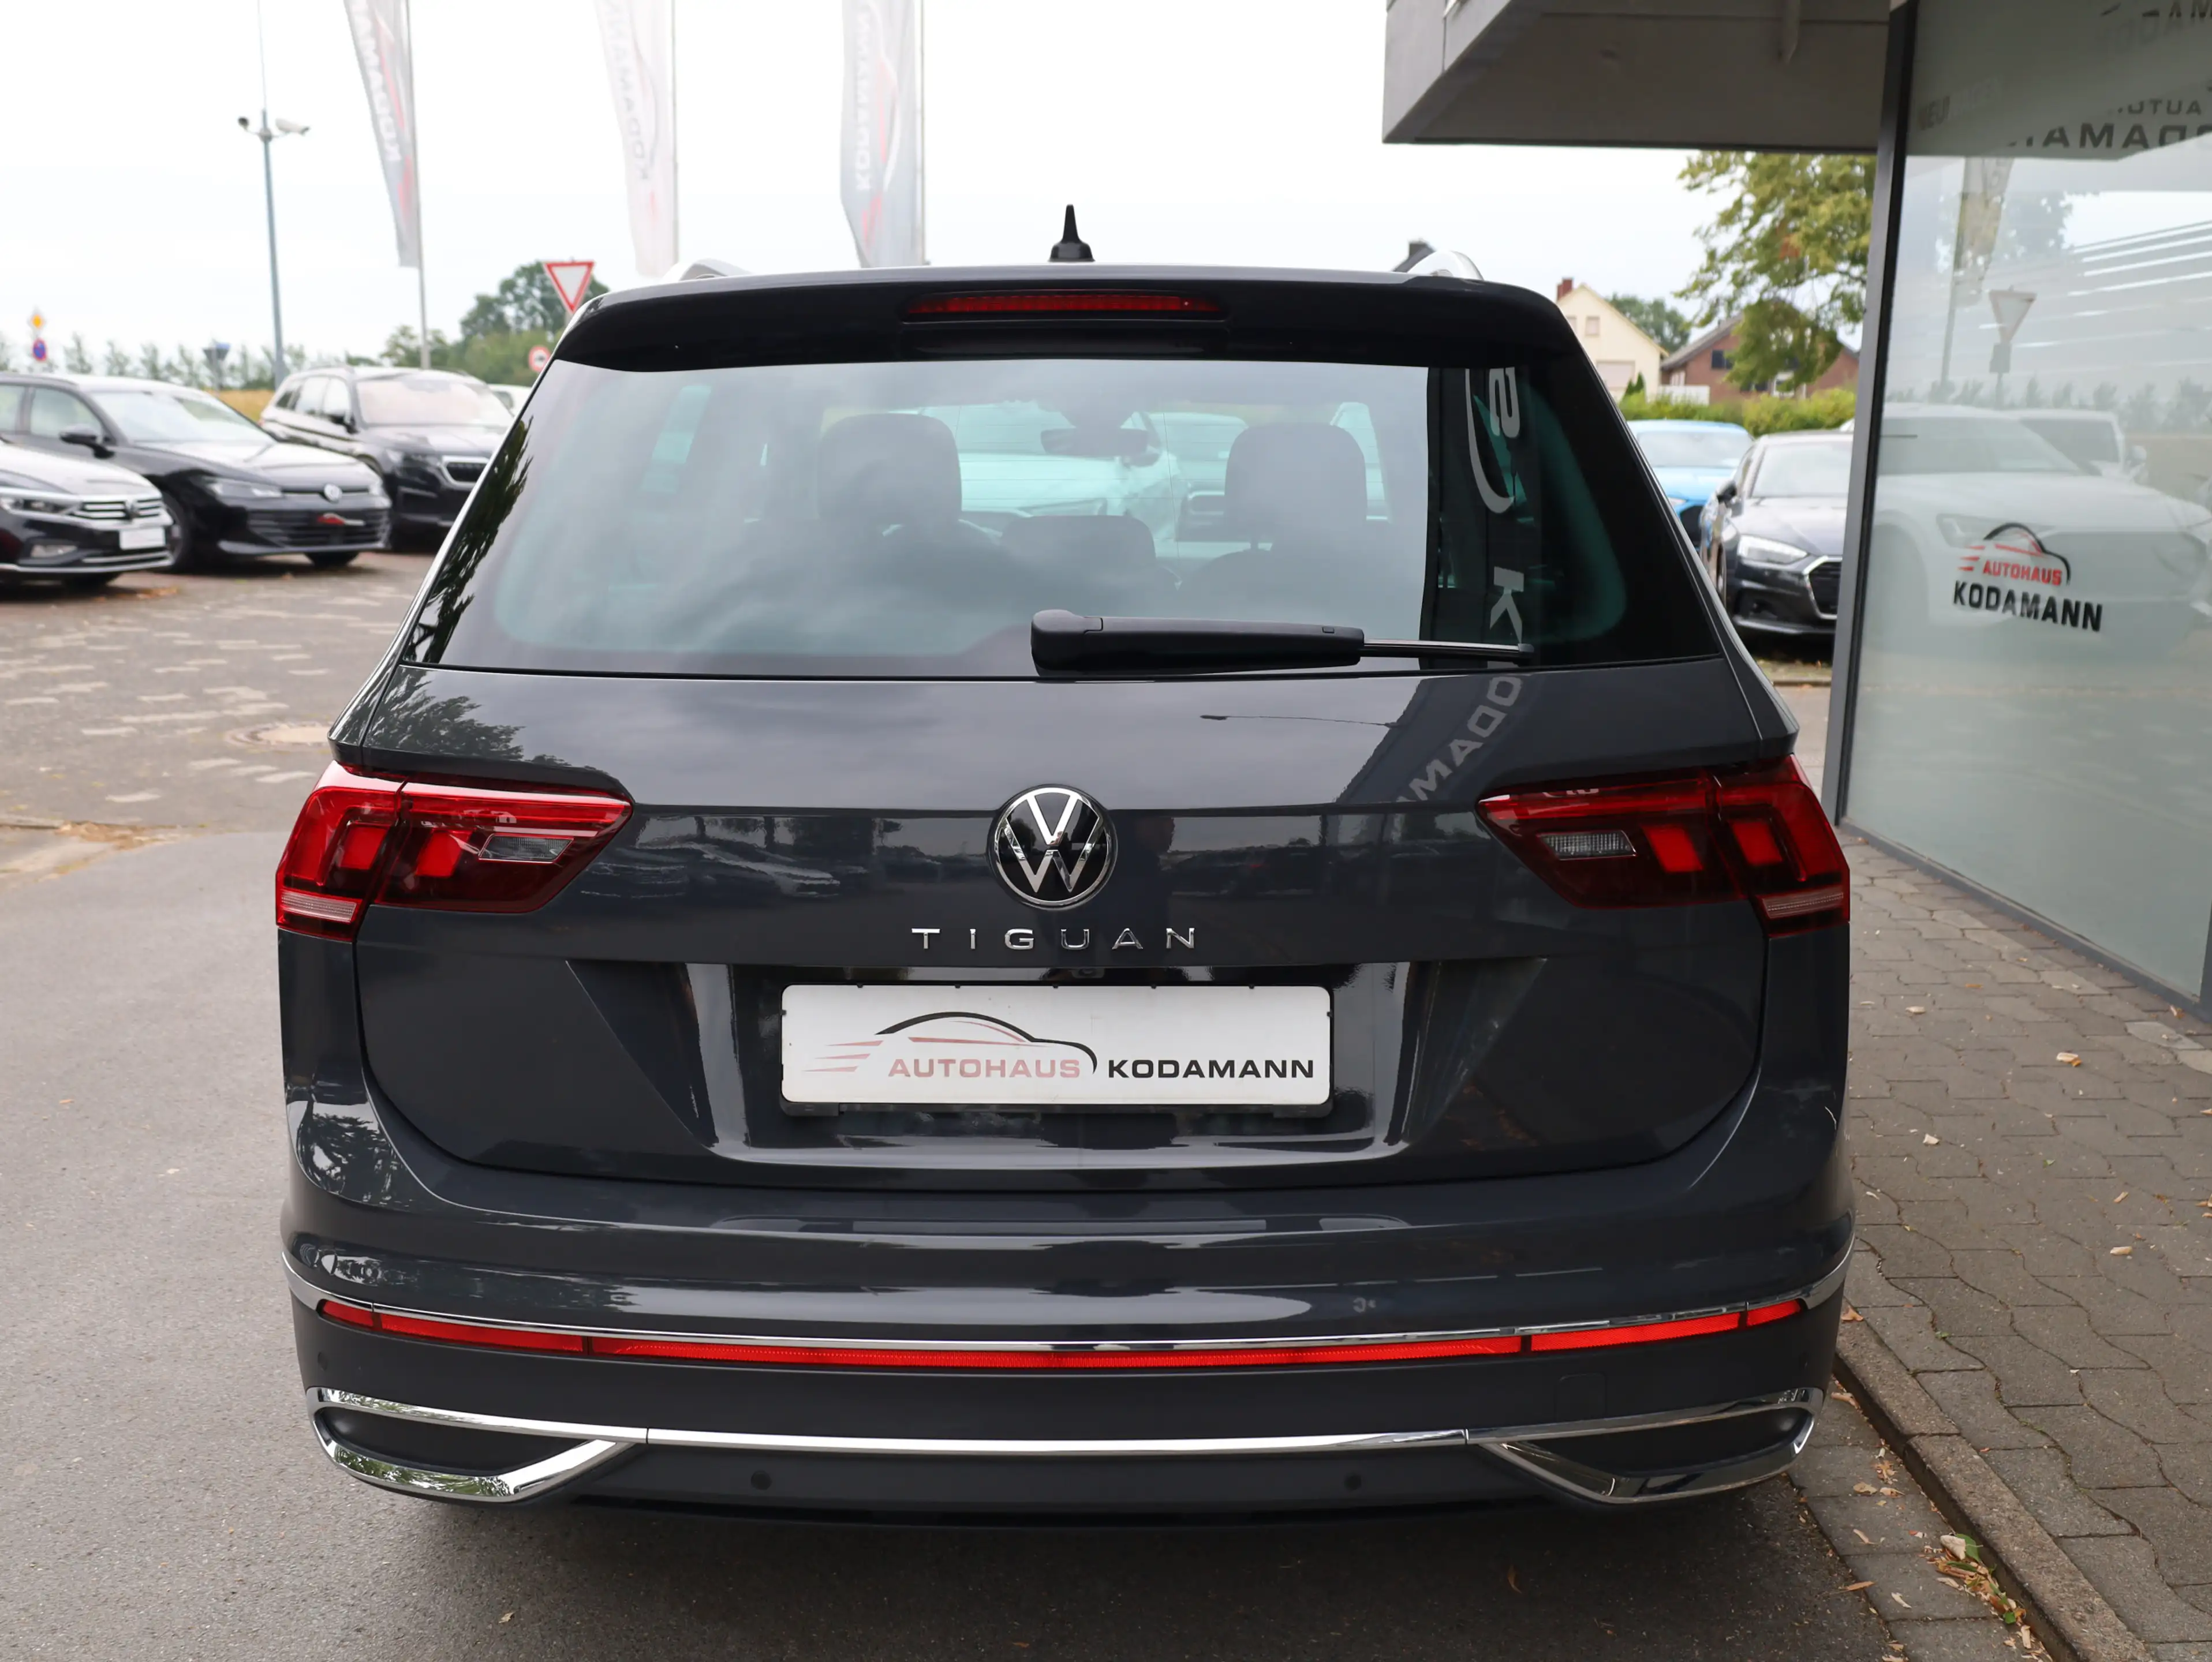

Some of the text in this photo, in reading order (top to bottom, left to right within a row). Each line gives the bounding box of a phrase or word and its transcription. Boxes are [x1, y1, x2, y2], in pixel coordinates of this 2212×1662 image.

[1983, 560, 2062, 586] AUTOHAUS
[1953, 580, 2103, 632] KODAMANN
[911, 927, 1195, 950] TIGUAN
[887, 1058, 1315, 1079] AUTOHAUS KODAMANN
